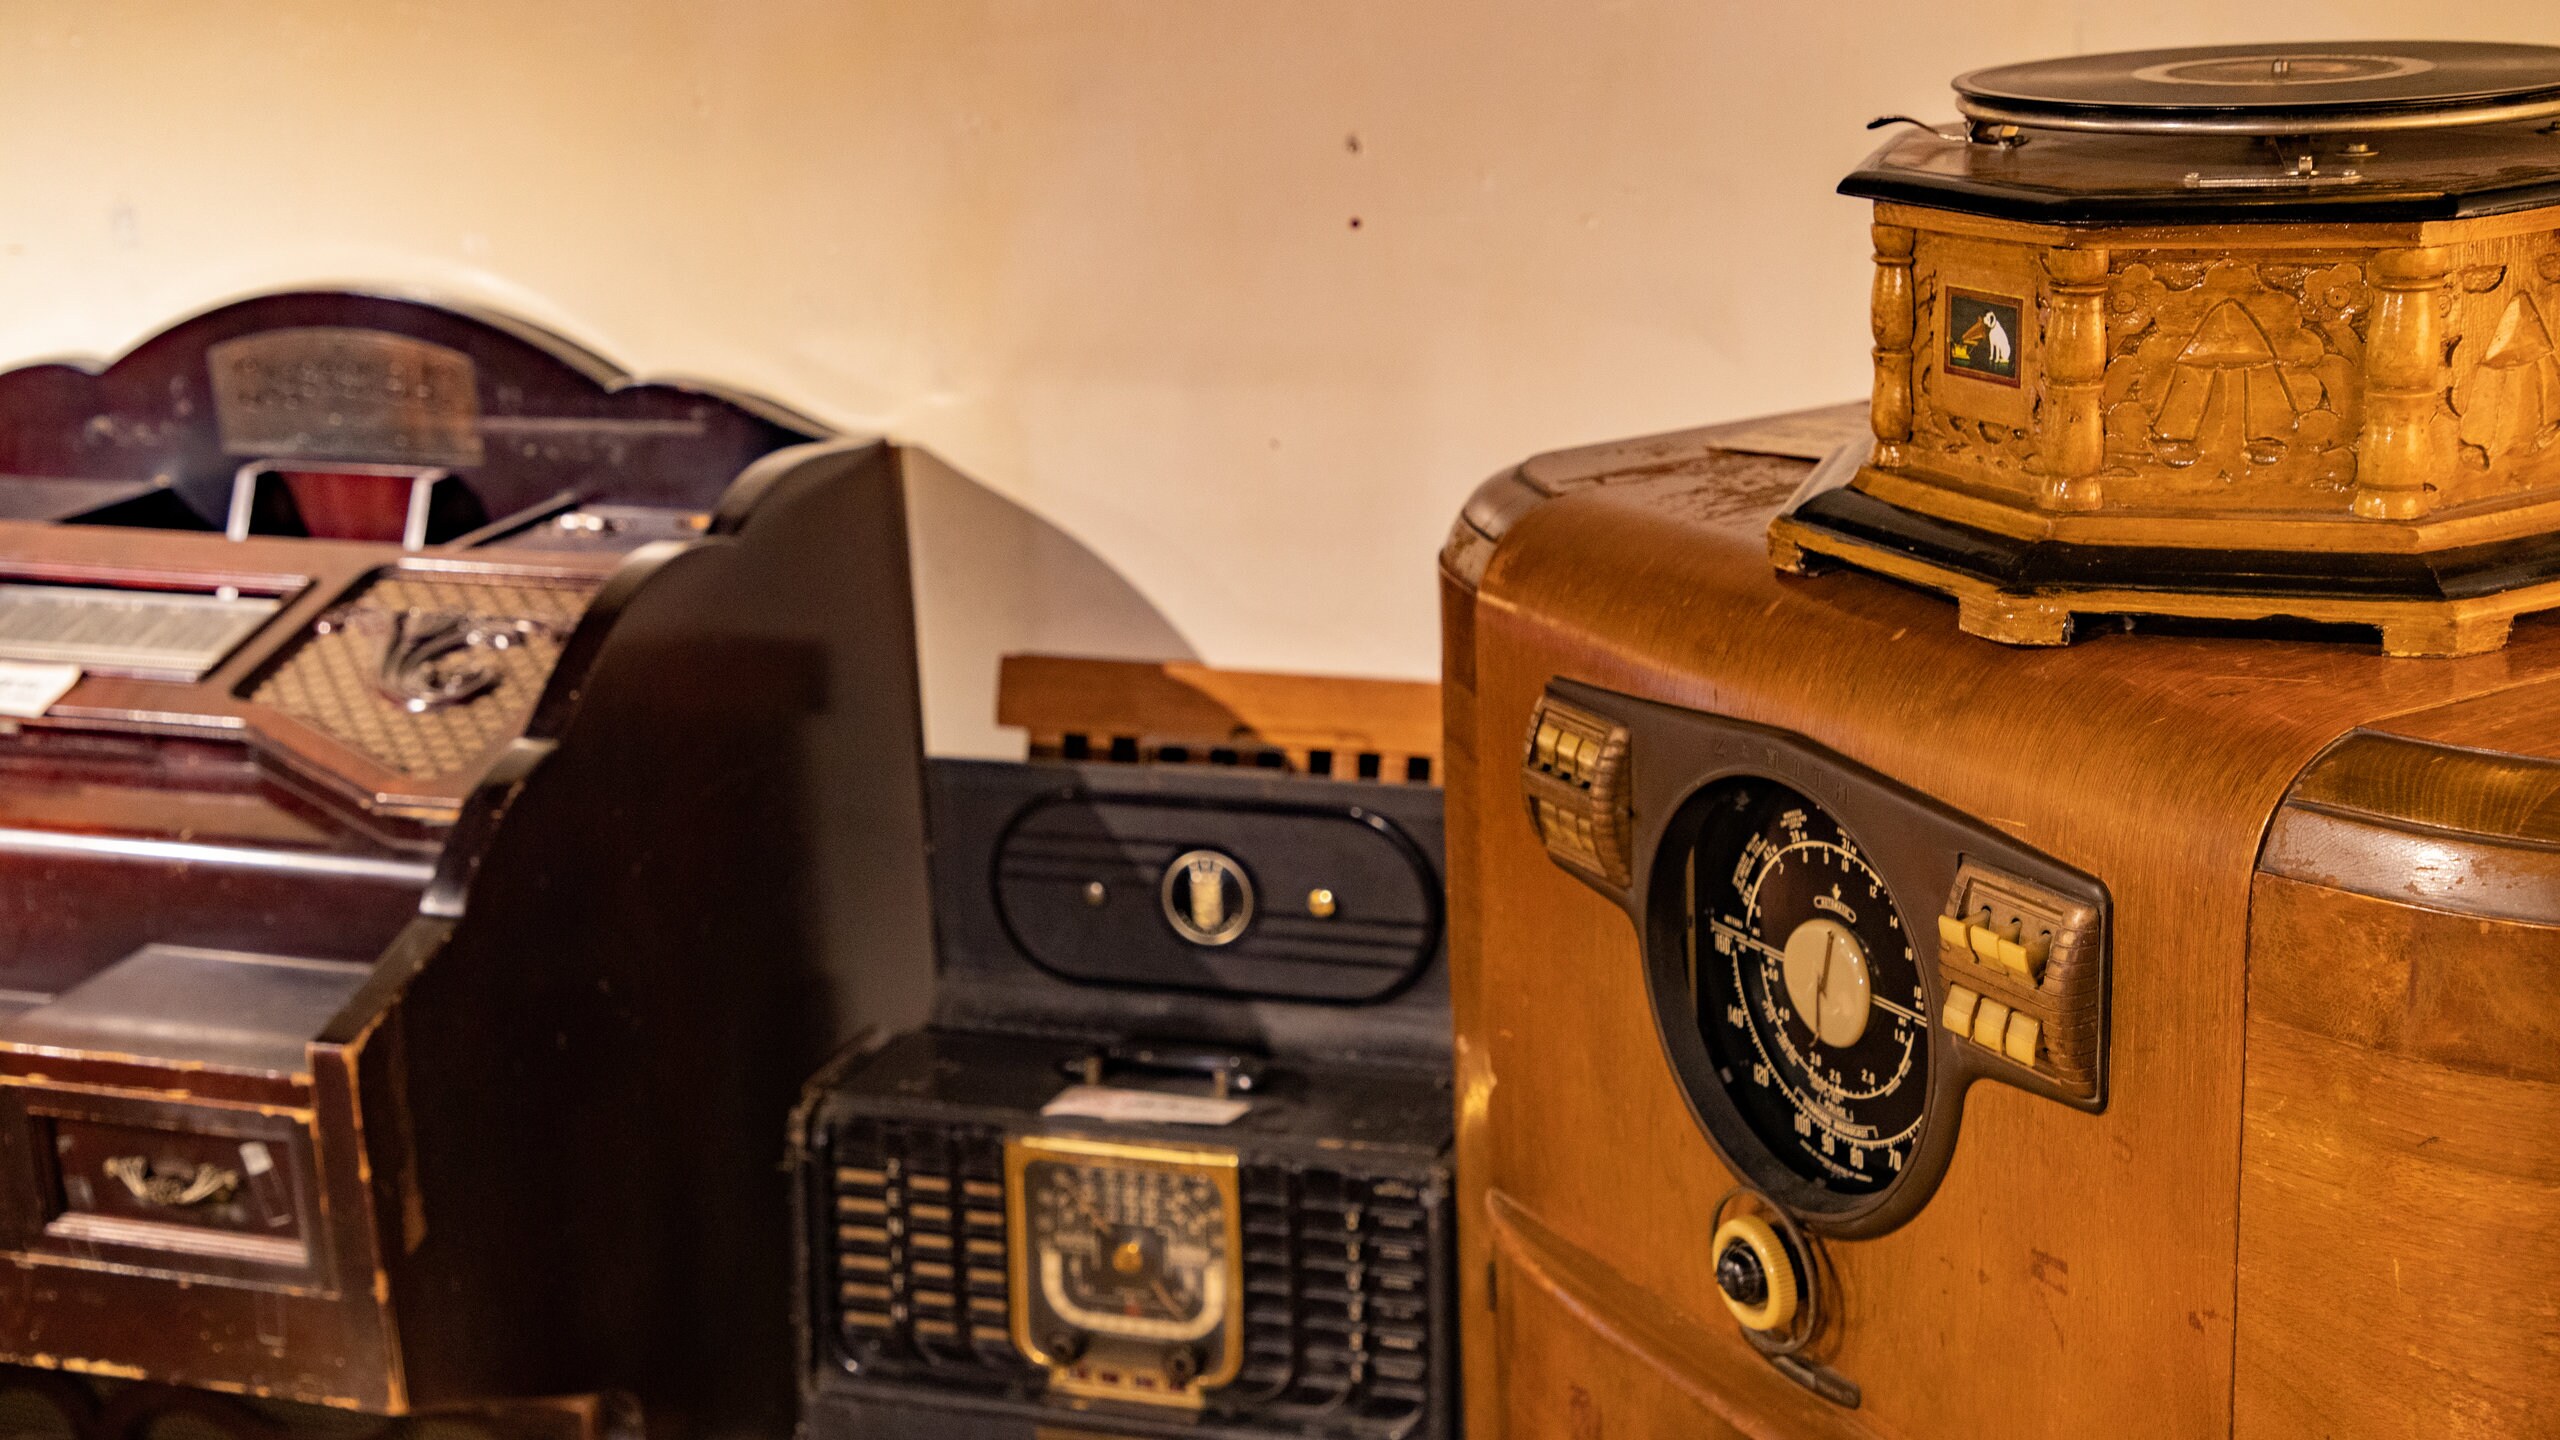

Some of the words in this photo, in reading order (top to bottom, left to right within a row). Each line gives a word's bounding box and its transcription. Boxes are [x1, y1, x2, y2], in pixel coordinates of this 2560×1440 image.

[1714, 736, 1850, 805] ZNITH
[1869, 883, 1878, 899] 12
[1889, 914, 1899, 929] 14
[1714, 932, 1731, 956] 160
[1726, 1003, 1744, 1029] 140
[1753, 1062, 1770, 1089] 120
[1793, 1111, 1812, 1138] 100
[1820, 1131, 1836, 1157] 90
[1887, 1147, 1902, 1172] 70
